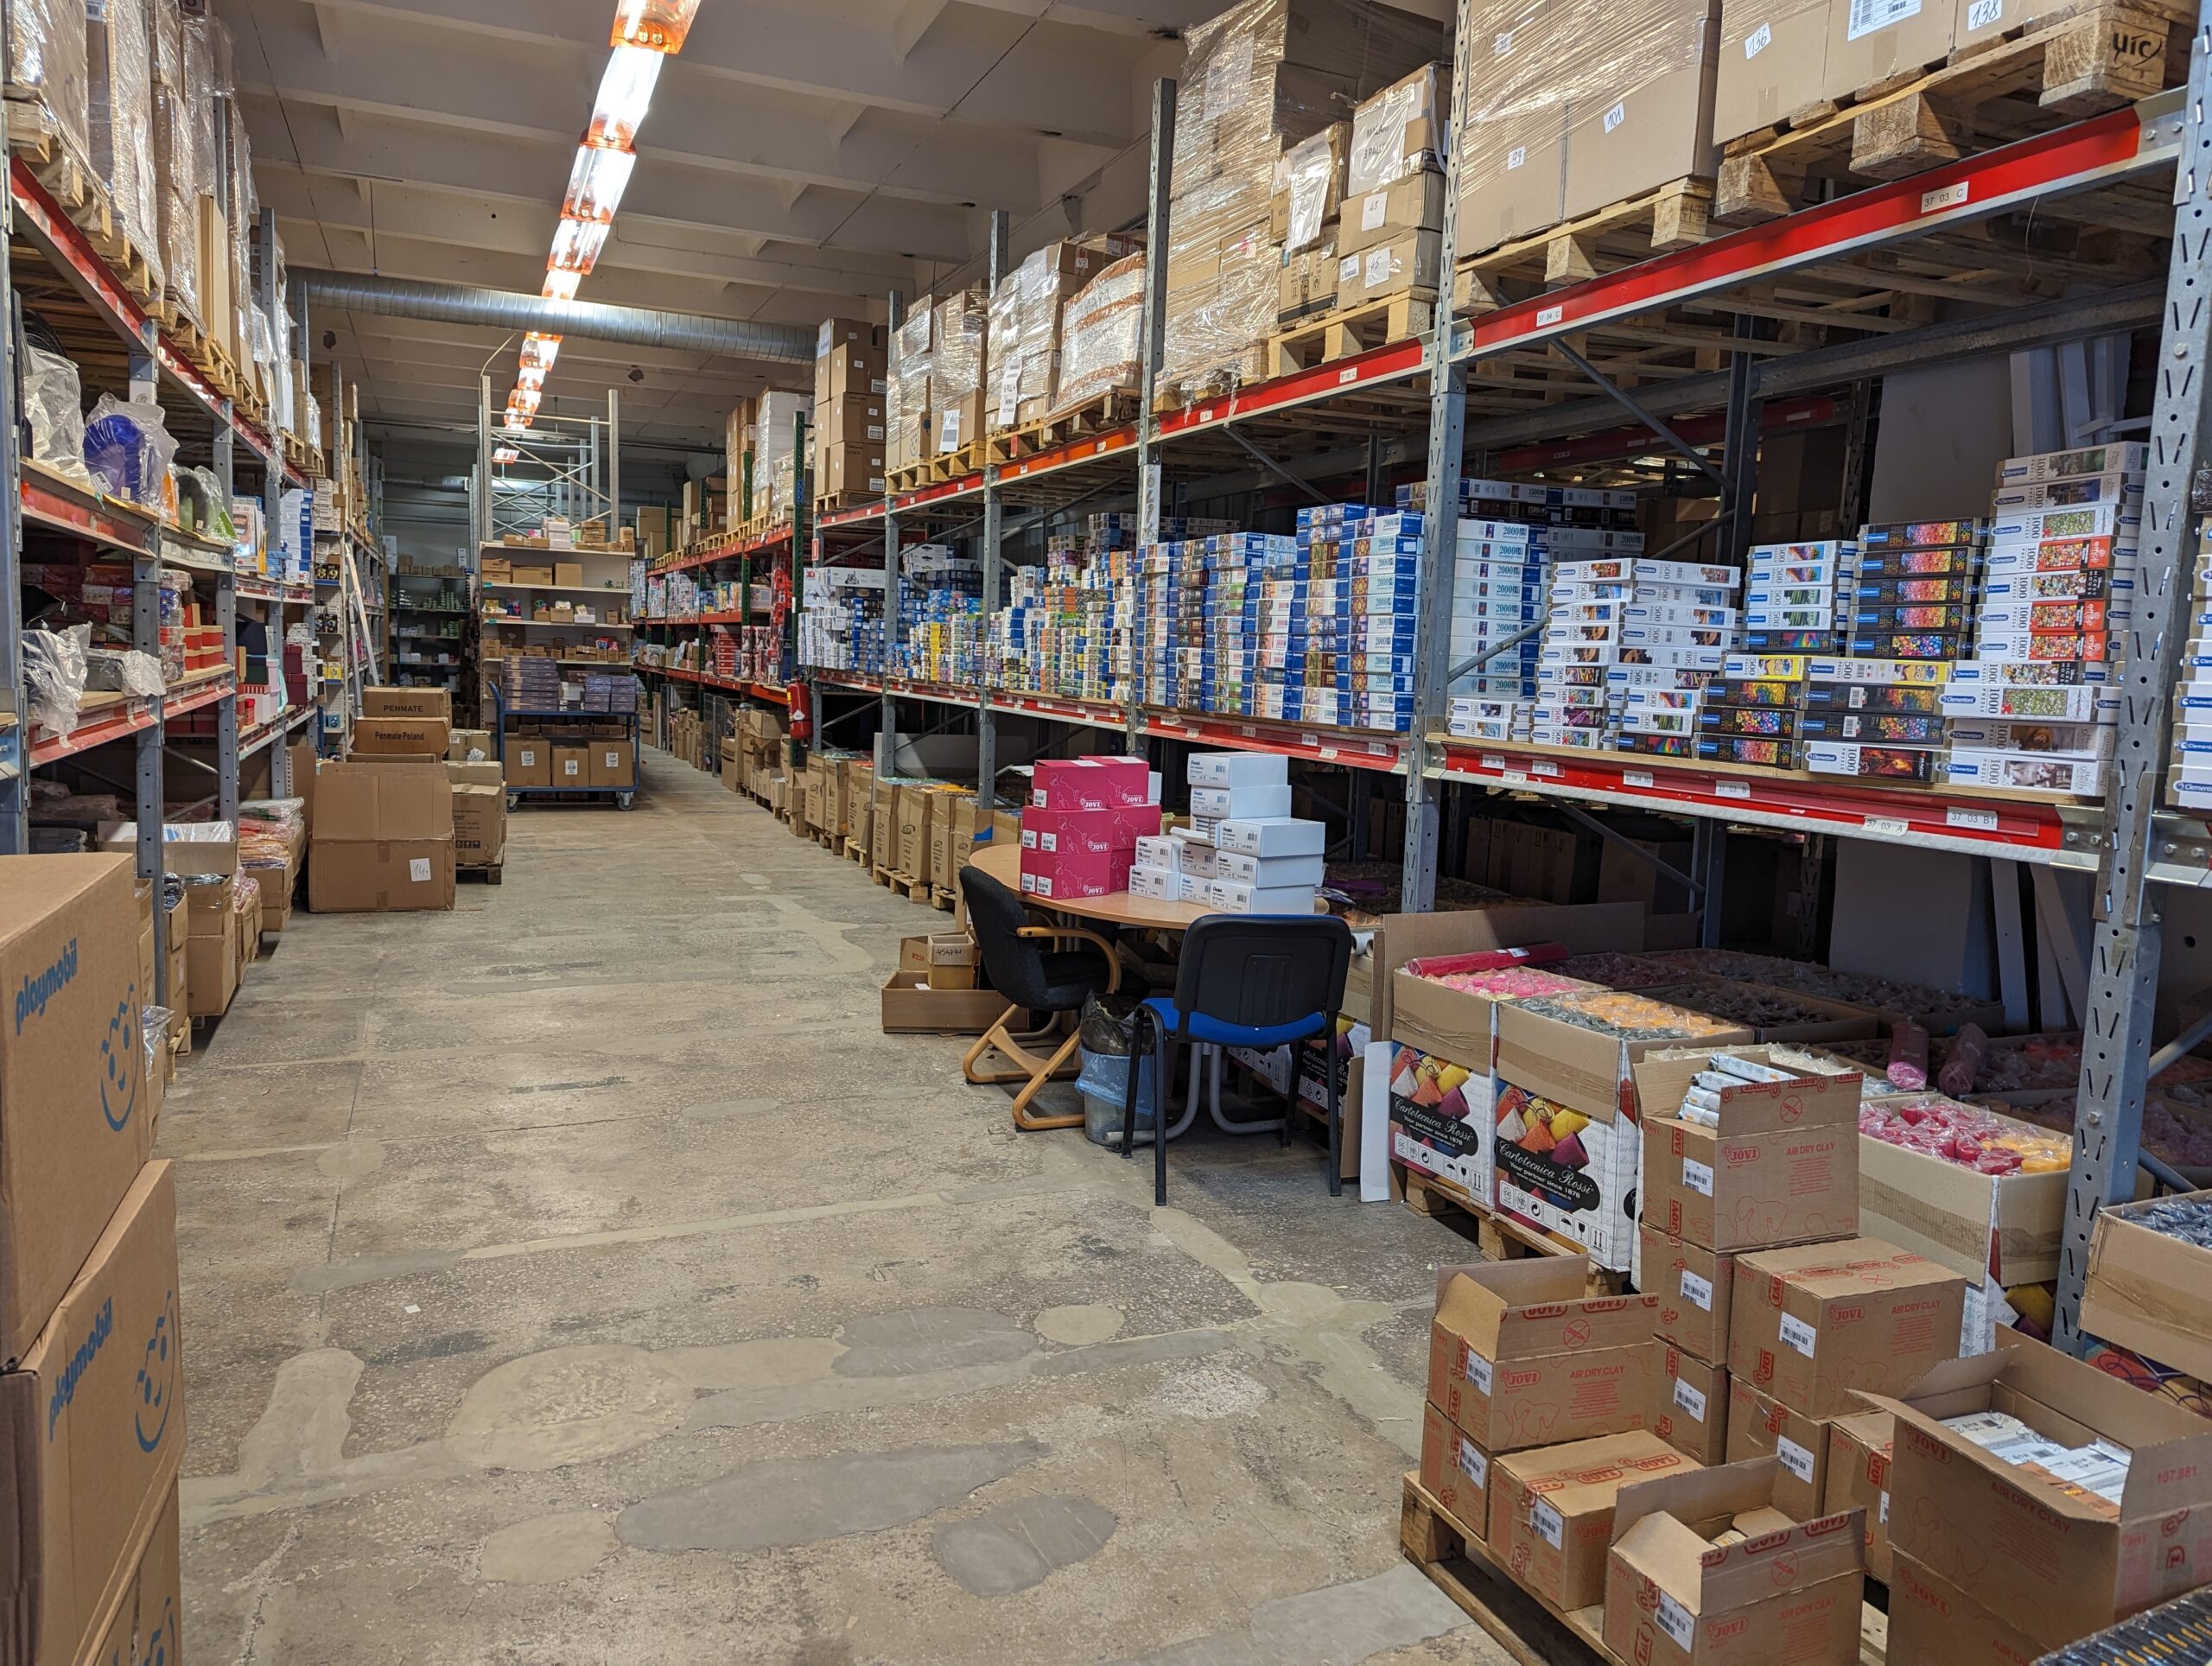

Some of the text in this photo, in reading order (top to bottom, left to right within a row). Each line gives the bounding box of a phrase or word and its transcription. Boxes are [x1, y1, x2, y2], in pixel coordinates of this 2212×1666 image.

[1972, 0, 1998, 27] 138
[1748, 28, 1768, 55] 136
[1606, 107, 1623, 128] 101
[1924, 188, 1964, 207] 37 03 C
[2036, 458, 2046, 480] 1000
[2035, 486, 2044, 509] 1000
[1503, 525, 1519, 536] 2000
[2031, 516, 2041, 539] 1000
[1499, 545, 1516, 555] 2000
[2026, 547, 2036, 569] 1000
[1497, 565, 1514, 575] 2000
[1496, 584, 1513, 594] 2000
[2018, 576, 2029, 599] 1000
[1496, 603, 1512, 614] 2000
[2018, 607, 2029, 629] 1000
[1497, 623, 1513, 633] 2000
[2017, 636, 2028, 658] 1000
[1495, 661, 1512, 671] 2000
[1843, 661, 1853, 680] 500
[1495, 680, 1512, 690] 2000
[383, 704, 423, 713] PENMATE
[1947, 696, 1974, 704] Clementoni
[1988, 688, 2000, 715] 1000
[374, 731, 424, 741] Penmate Poland
[1955, 731, 1983, 740] Clementoni
[1996, 725, 2008, 750] 1000
[1847, 747, 1858, 772] 1000
[1951, 765, 1977, 773] Clementoni
[1988, 759, 2001, 785] 1000
[1718, 784, 1726, 792] 37
[1728, 785, 1737, 793] 03
[1867, 819, 1903, 833] 37 03 A
[1951, 812, 1994, 825] 37 03 B1
[16, 937, 78, 1037] playmobil
[1395, 1096, 1472, 1141] Cartotecnica Rossi
[1403, 1115, 1463, 1146] Your partner since 1878
[1729, 1148, 1757, 1160] JOVI
[1786, 1141, 1835, 1156] AIR DRY CLAY
[1499, 1140, 1593, 1195] Cartotecnica Rossi
[1510, 1160, 1580, 1199] Your partner since 1878
[1834, 1306, 1862, 1320] JOVI
[1891, 1299, 1942, 1315] AIR DRY CLAY
[48, 1295, 113, 1443] playmobil
[1511, 1372, 1538, 1385] JOVI
[1569, 1364, 1626, 1379] AIR DRY CLAY
[1912, 1434, 1948, 1462] JOVI
[1990, 1479, 2071, 1534] AIR DRY CLAY
[1778, 1597, 1837, 1621] AIR DRY CLAY
[1912, 1584, 1948, 1616] JOVI
[1715, 1620, 1745, 1639] JOVI
